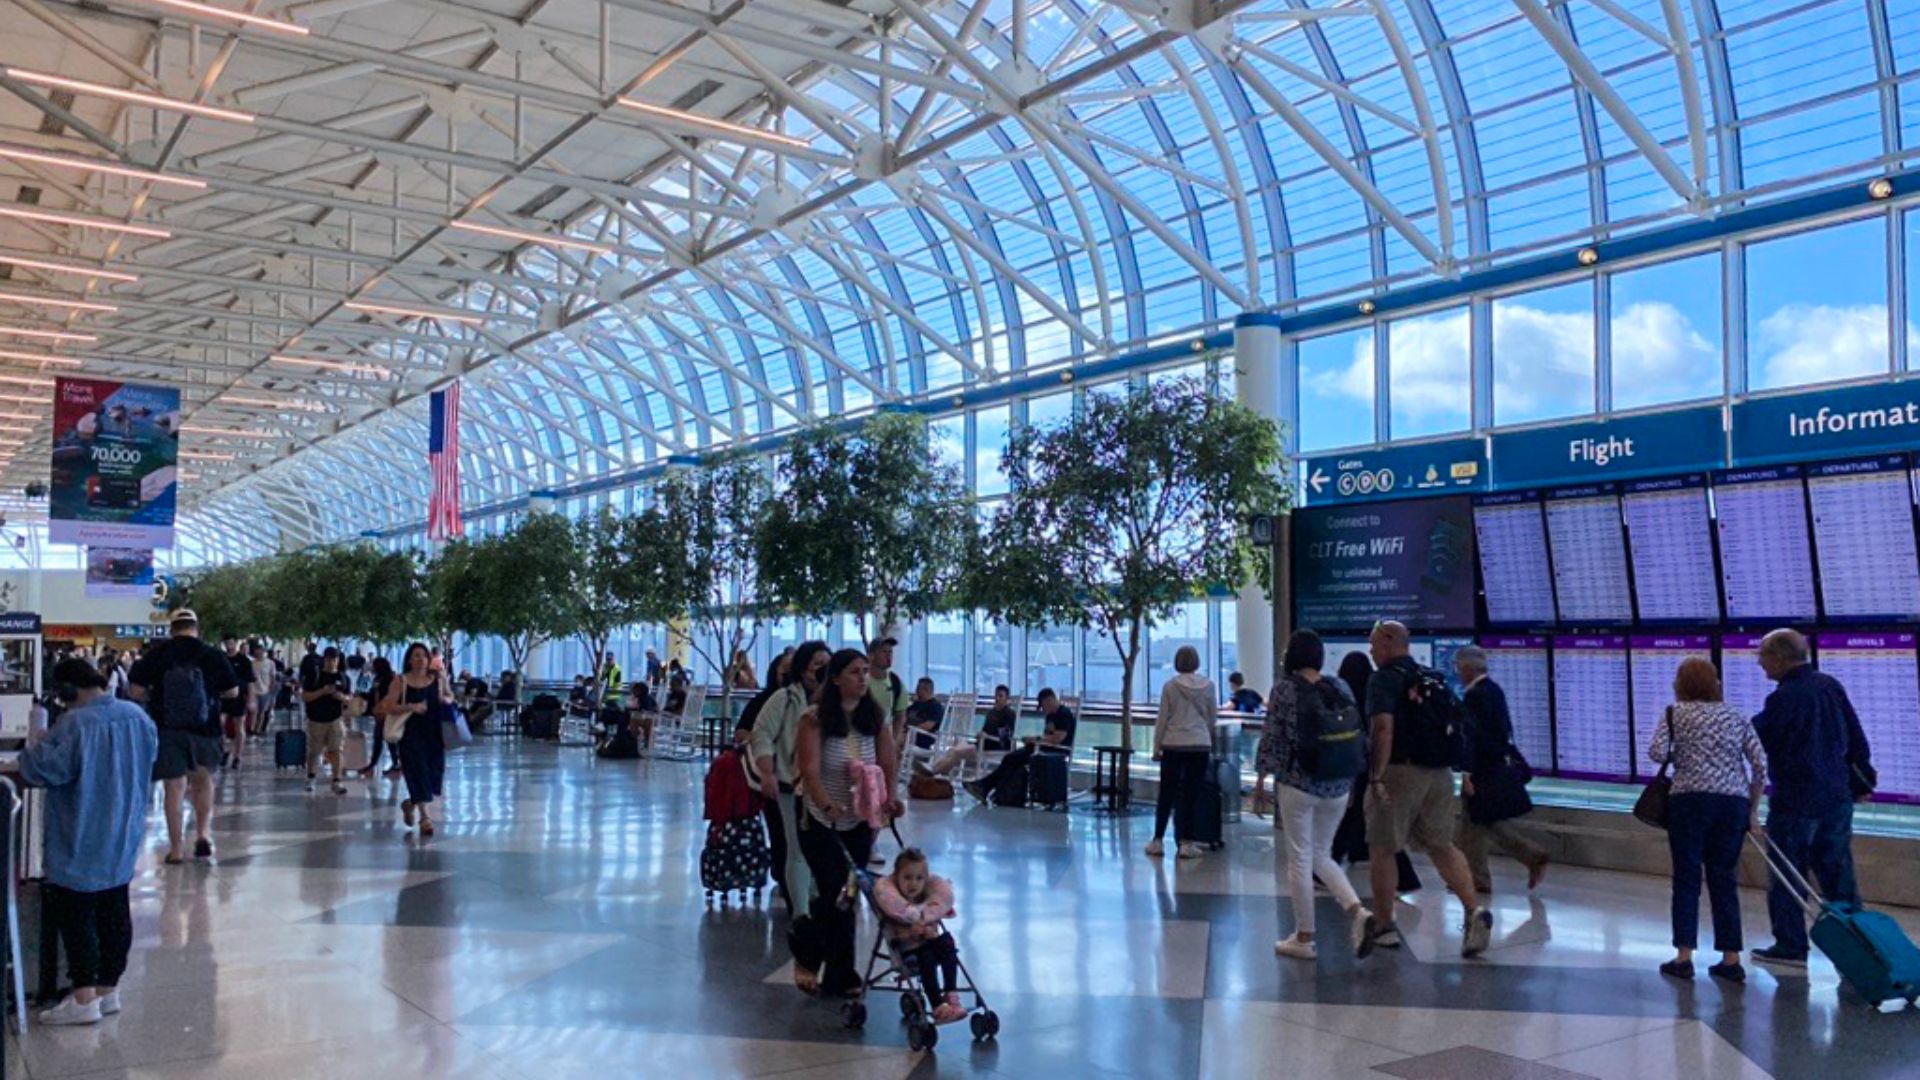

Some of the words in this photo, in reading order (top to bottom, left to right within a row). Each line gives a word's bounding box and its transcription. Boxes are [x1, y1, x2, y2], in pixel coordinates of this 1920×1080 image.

[63, 382, 93, 393] More
[1790, 402, 1920, 437] Informat
[1569, 435, 1635, 466] Flight
[1338, 460, 1364, 470] Gates
[1822, 460, 1880, 474] DEPARTURES
[1726, 470, 1778, 482] DEPARTURES
[1326, 515, 1368, 529] Connect
[1370, 514, 1381, 526] to
[1309, 541, 1335, 559] CLT
[1335, 541, 1367, 558] Free
[1370, 536, 1405, 557] WiFi
[1345, 566, 1383, 578] unlimited
[1318, 580, 1377, 592] complimentary
[1378, 579, 1398, 591] WiFi
[1846, 637, 1885, 647] ARRIVALS
